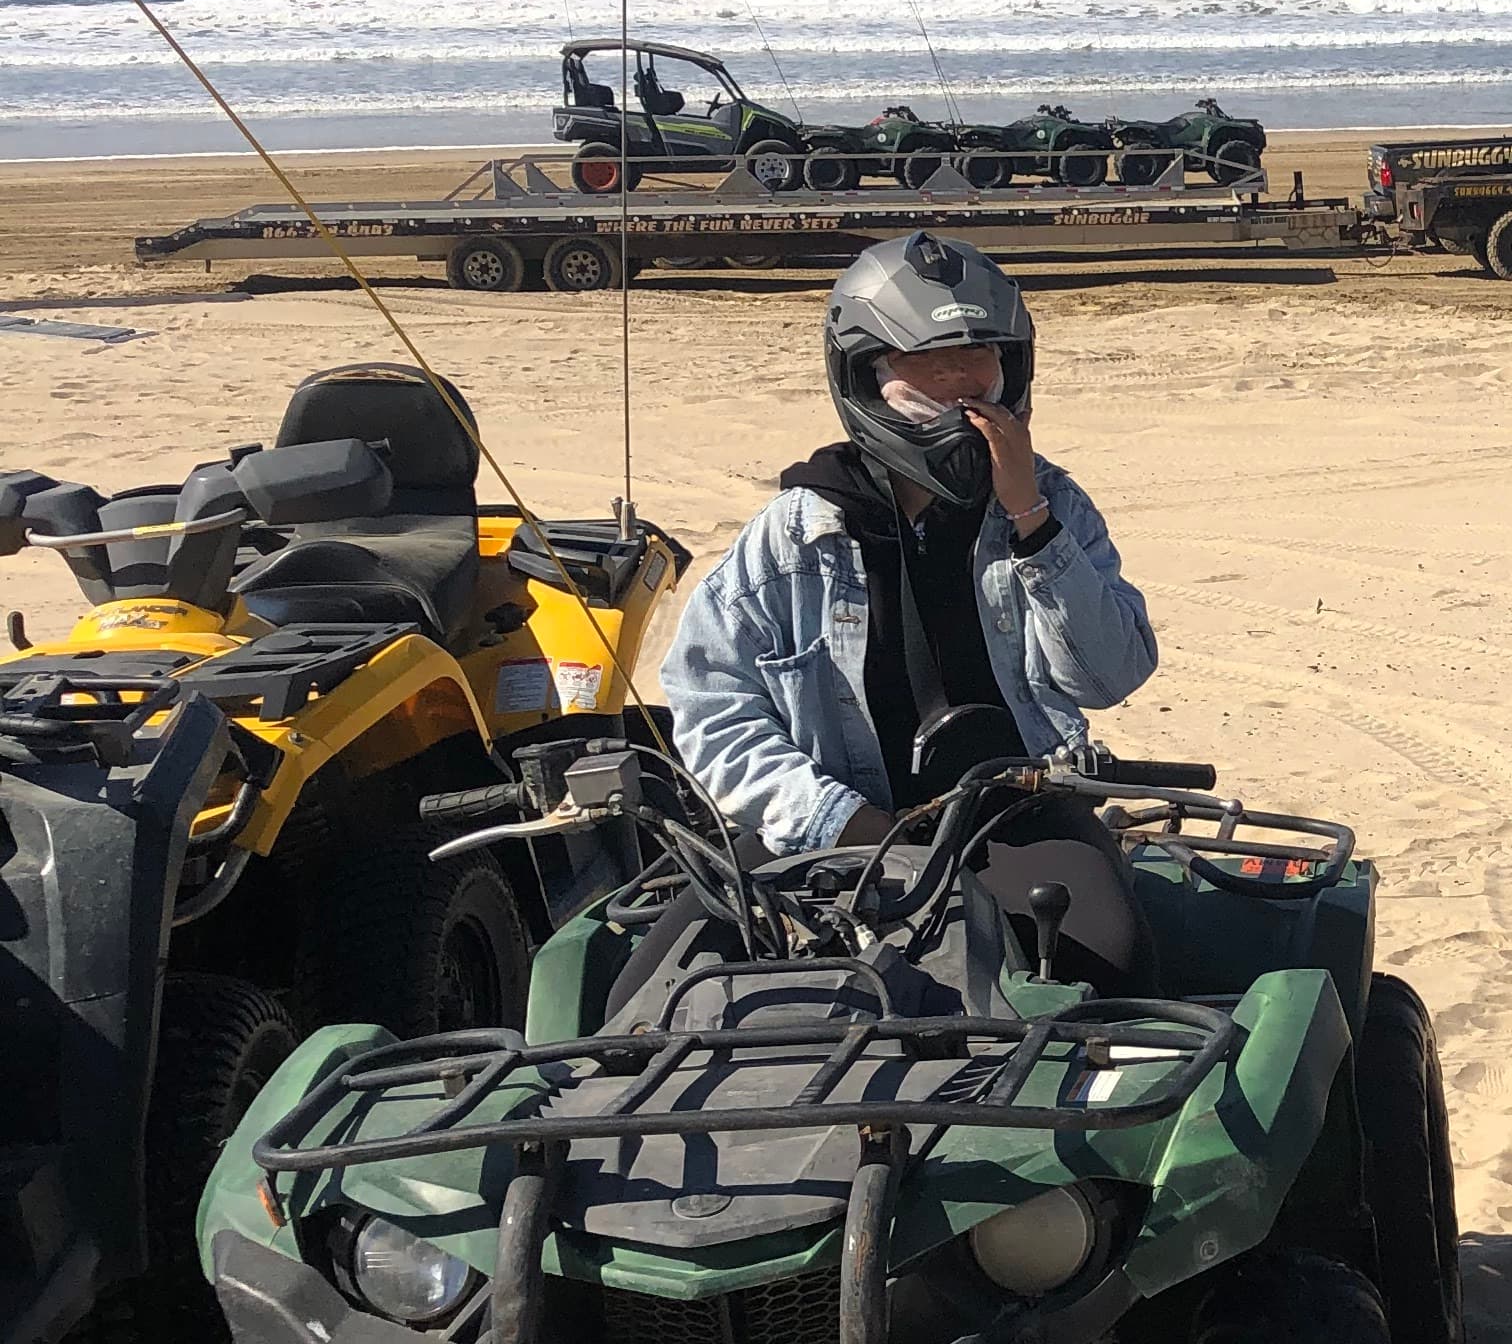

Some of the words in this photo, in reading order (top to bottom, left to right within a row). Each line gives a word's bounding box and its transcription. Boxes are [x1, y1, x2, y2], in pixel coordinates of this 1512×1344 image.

[596, 220, 657, 233] WHERE
[663, 219, 695, 232] THE
[700, 219, 735, 231] FUN
[740, 218, 796, 231] NEVER
[800, 217, 841, 230] SETS
[1054, 212, 1150, 225] SUNBUGGIE
